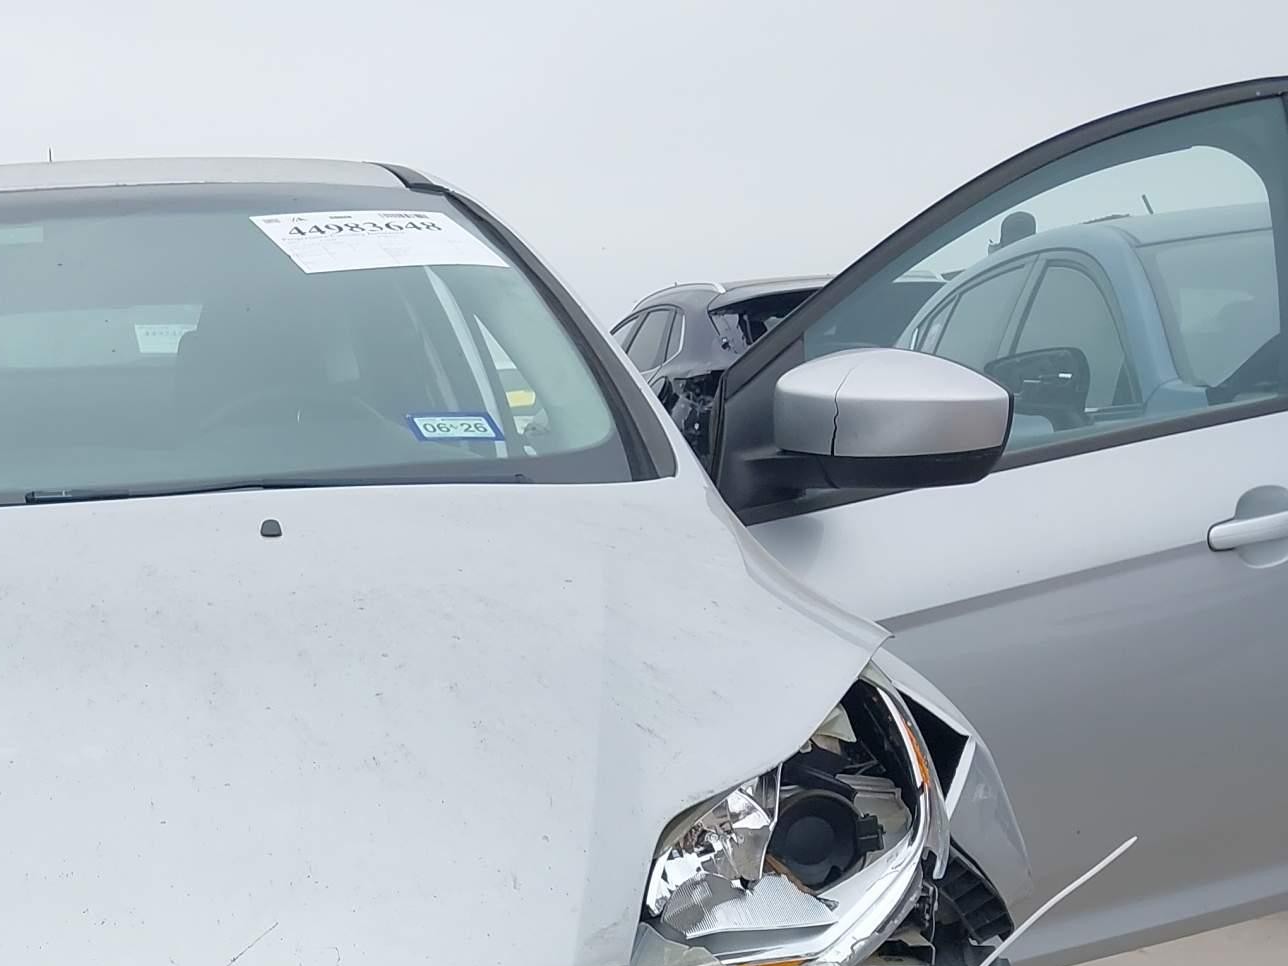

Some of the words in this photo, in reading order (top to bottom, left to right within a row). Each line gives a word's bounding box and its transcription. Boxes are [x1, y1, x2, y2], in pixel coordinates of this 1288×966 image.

[288, 221, 443, 236] 44983648
[422, 422, 450, 432] 06
[460, 422, 488, 432] 26
